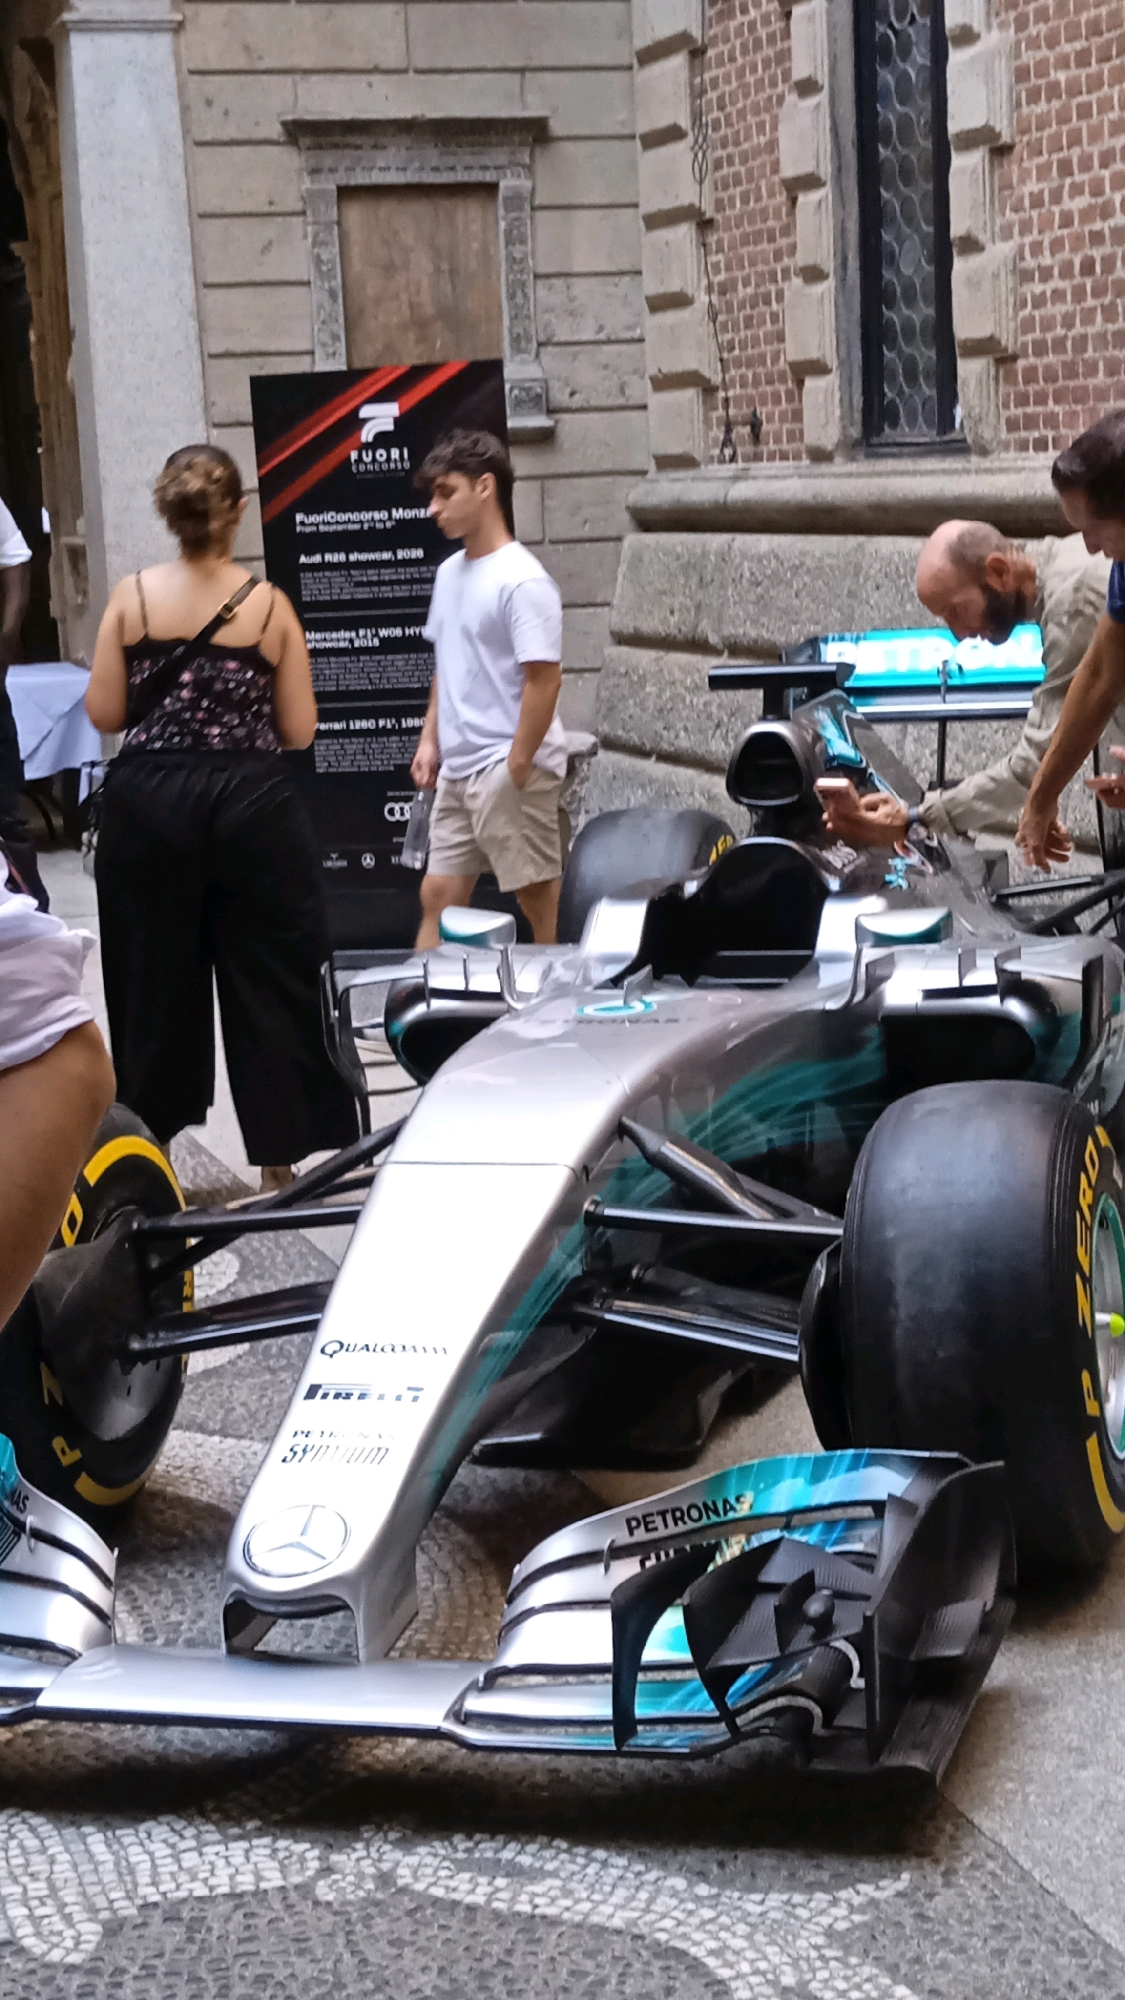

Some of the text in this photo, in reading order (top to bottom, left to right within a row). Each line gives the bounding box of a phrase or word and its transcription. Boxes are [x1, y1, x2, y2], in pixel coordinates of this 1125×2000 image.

[350, 447, 409, 463] FUORI
[352, 460, 410, 474] CONCORSO
[295, 509, 388, 524] FuoriConcorso
[296, 523, 317, 533] From
[319, 521, 361, 532] September
[299, 553, 322, 564] Audi
[348, 550, 394, 562] showcar,
[305, 629, 356, 641] Mercedes
[1075, 1134, 1099, 1339] ZERO
[625, 1491, 754, 1538] PETRONAS
